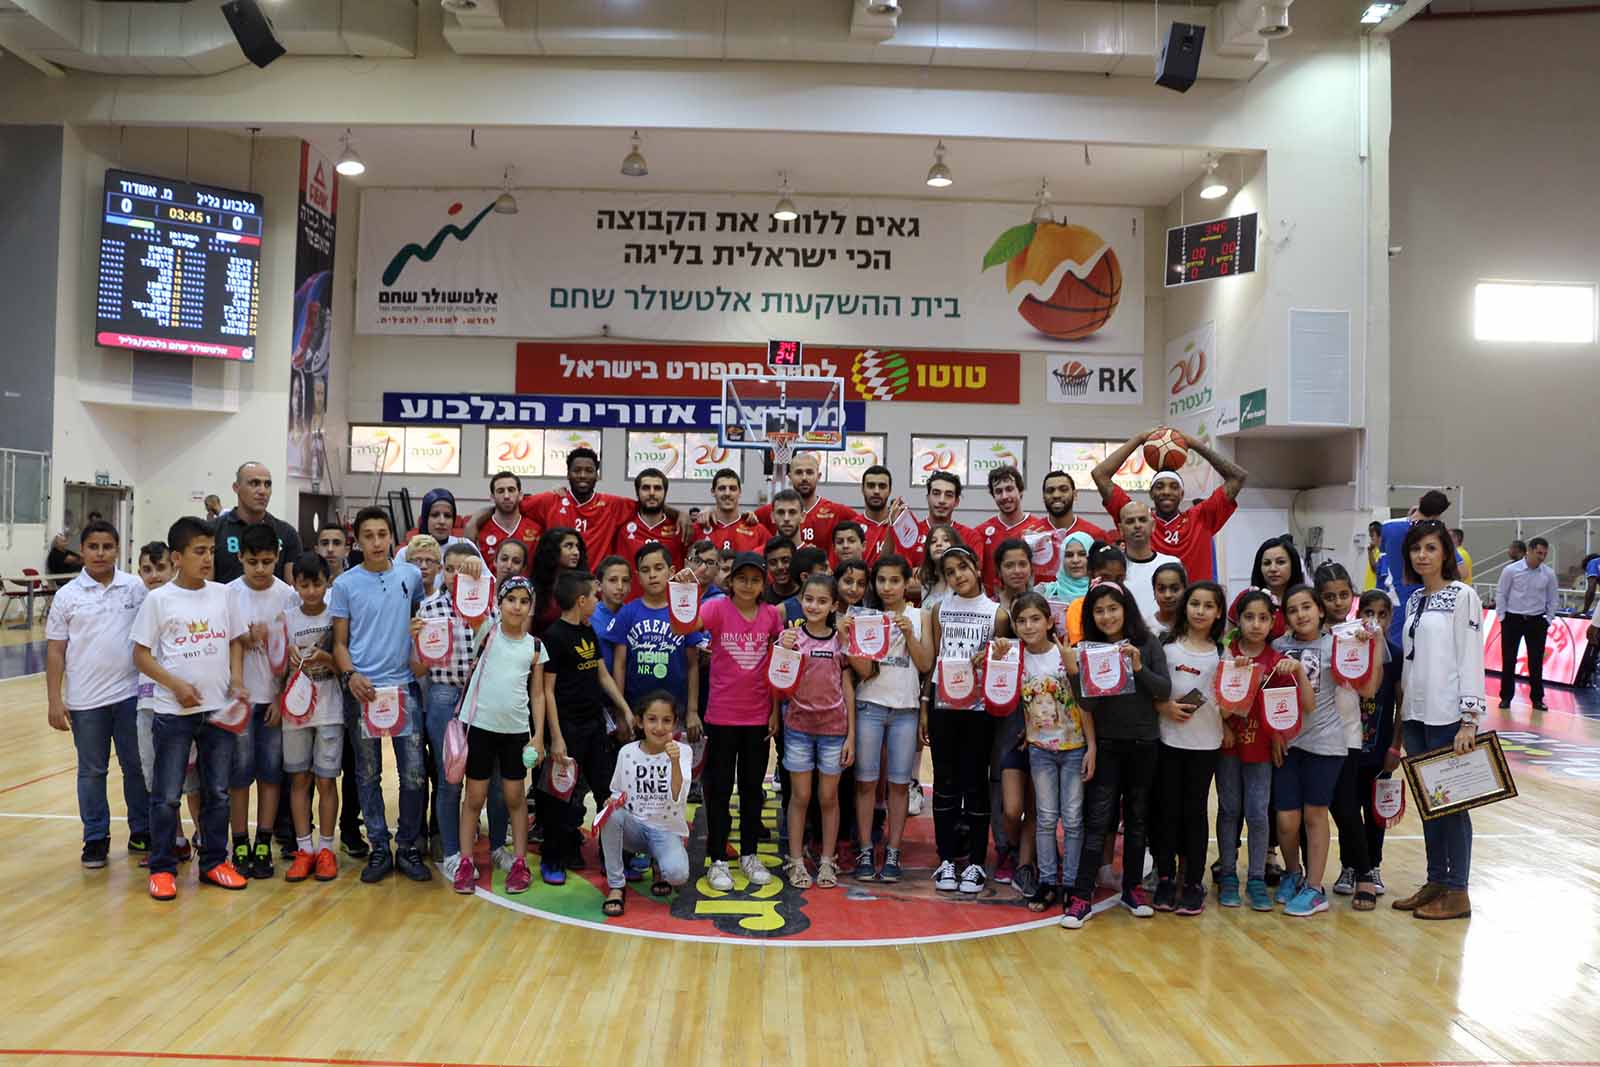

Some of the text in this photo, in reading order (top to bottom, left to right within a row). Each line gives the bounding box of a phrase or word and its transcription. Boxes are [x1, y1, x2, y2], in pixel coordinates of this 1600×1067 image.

[120, 181, 173, 200] מ. אשדוד
[121, 198, 132, 213] 0
[222, 198, 255, 214] גלבוע
[169, 208, 203, 223] 03:45
[232, 216, 243, 231] 0
[597, 208, 706, 235] הקבוצה
[715, 212, 759, 234] את
[856, 215, 920, 238] גאים
[624, 241, 892, 270] הכי ישראלית בליגה
[1222, 240, 1236, 255] 00
[1191, 268, 1198, 279] 0
[1221, 263, 1228, 275] 0
[379, 288, 498, 305] אלטשולר שחם
[549, 285, 961, 320] בית ההשקעות אלטשולר שחם
[559, 353, 659, 380] בישראל
[775, 351, 795, 364] 24
[767, 358, 838, 382] למע
[916, 363, 988, 389] טוטו
[1168, 350, 1207, 395] 20
[1099, 367, 1138, 394] RK
[400, 396, 546, 423] הגלבוע
[1170, 385, 1213, 416] לעטרה
[558, 401, 696, 425] אזורית
[498, 440, 530, 462] 20
[634, 451, 666, 462] עטרה
[693, 444, 731, 465] 20
[920, 449, 956, 472] 20
[833, 456, 866, 466] עטרה
[576, 518, 587, 532] 21
[802, 527, 814, 540] 18
[1164, 530, 1179, 544] 24
[627, 619, 685, 646] AUTHENC
[638, 664, 653, 675] NR.
[636, 765, 667, 778] DIV
[636, 780, 668, 793] INE
